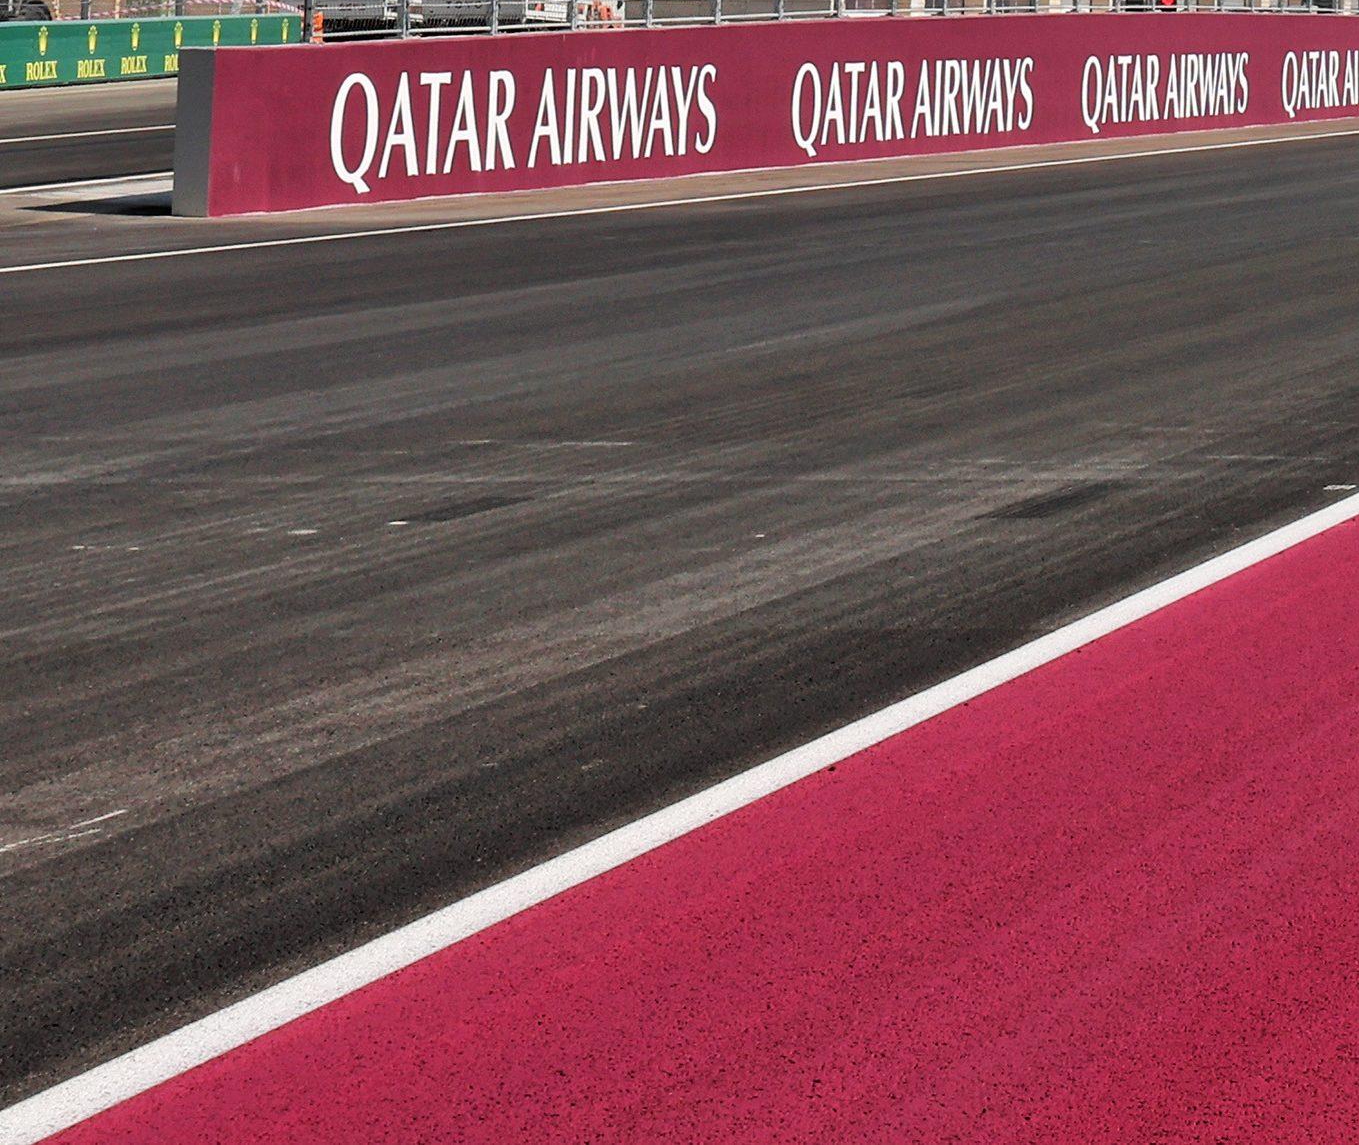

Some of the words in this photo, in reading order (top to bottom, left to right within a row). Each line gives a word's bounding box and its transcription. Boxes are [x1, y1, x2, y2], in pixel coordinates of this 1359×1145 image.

[26, 60, 58, 82] ROLEX
[77, 58, 106, 79] ROLEX
[120, 55, 148, 75] ROLEX
[164, 54, 180, 72] ROL
[1282, 51, 1340, 118] QATAR
[791, 61, 904, 157] QATAR
[910, 56, 1034, 139] AIRWAYS
[1081, 54, 1160, 134] QATAR
[1163, 52, 1249, 120] AIRWAYS
[330, 69, 516, 194] QATAR
[527, 63, 717, 169] AIRWAYS
